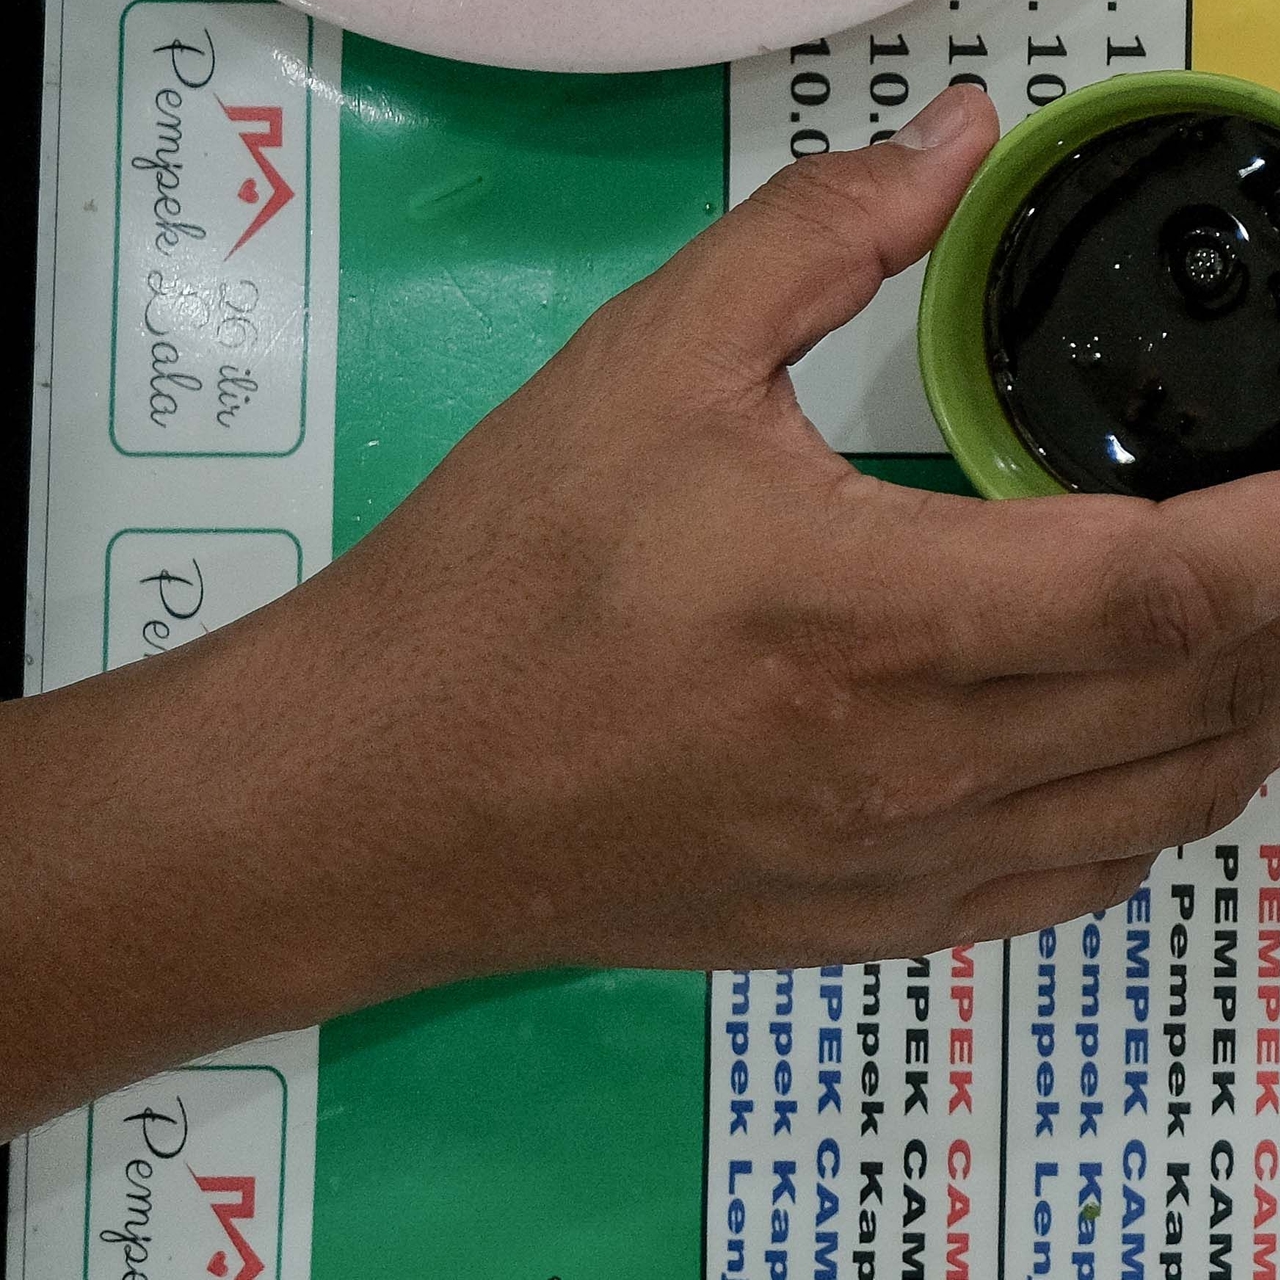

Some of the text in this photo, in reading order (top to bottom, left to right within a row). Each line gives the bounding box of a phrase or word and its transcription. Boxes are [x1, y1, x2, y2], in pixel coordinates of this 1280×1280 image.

[1106, 34, 1147, 67] 1
[130, 26, 216, 428] Pempek Lala
[216, 279, 259, 428] 26 ilir
[721, 970, 754, 1280] mpek Len
[763, 970, 798, 1280] mpek Kap
[813, 964, 843, 1280] PEK CAM
[851, 964, 884, 1280] mpek Kap
[901, 957, 929, 1280] PEK CAM
[945, 942, 974, 1280] MPEK CAM
[1026, 928, 1059, 1280] empek Len
[1072, 911, 1106, 1280] empek Kap
[1120, 877, 1151, 1280] EMPEK CAM
[1158, 883, 1196, 1280] Pempek Kap
[1208, 844, 1240, 1280] PEMPEK CAM
[1252, 1138, 1279, 1280] CAM
